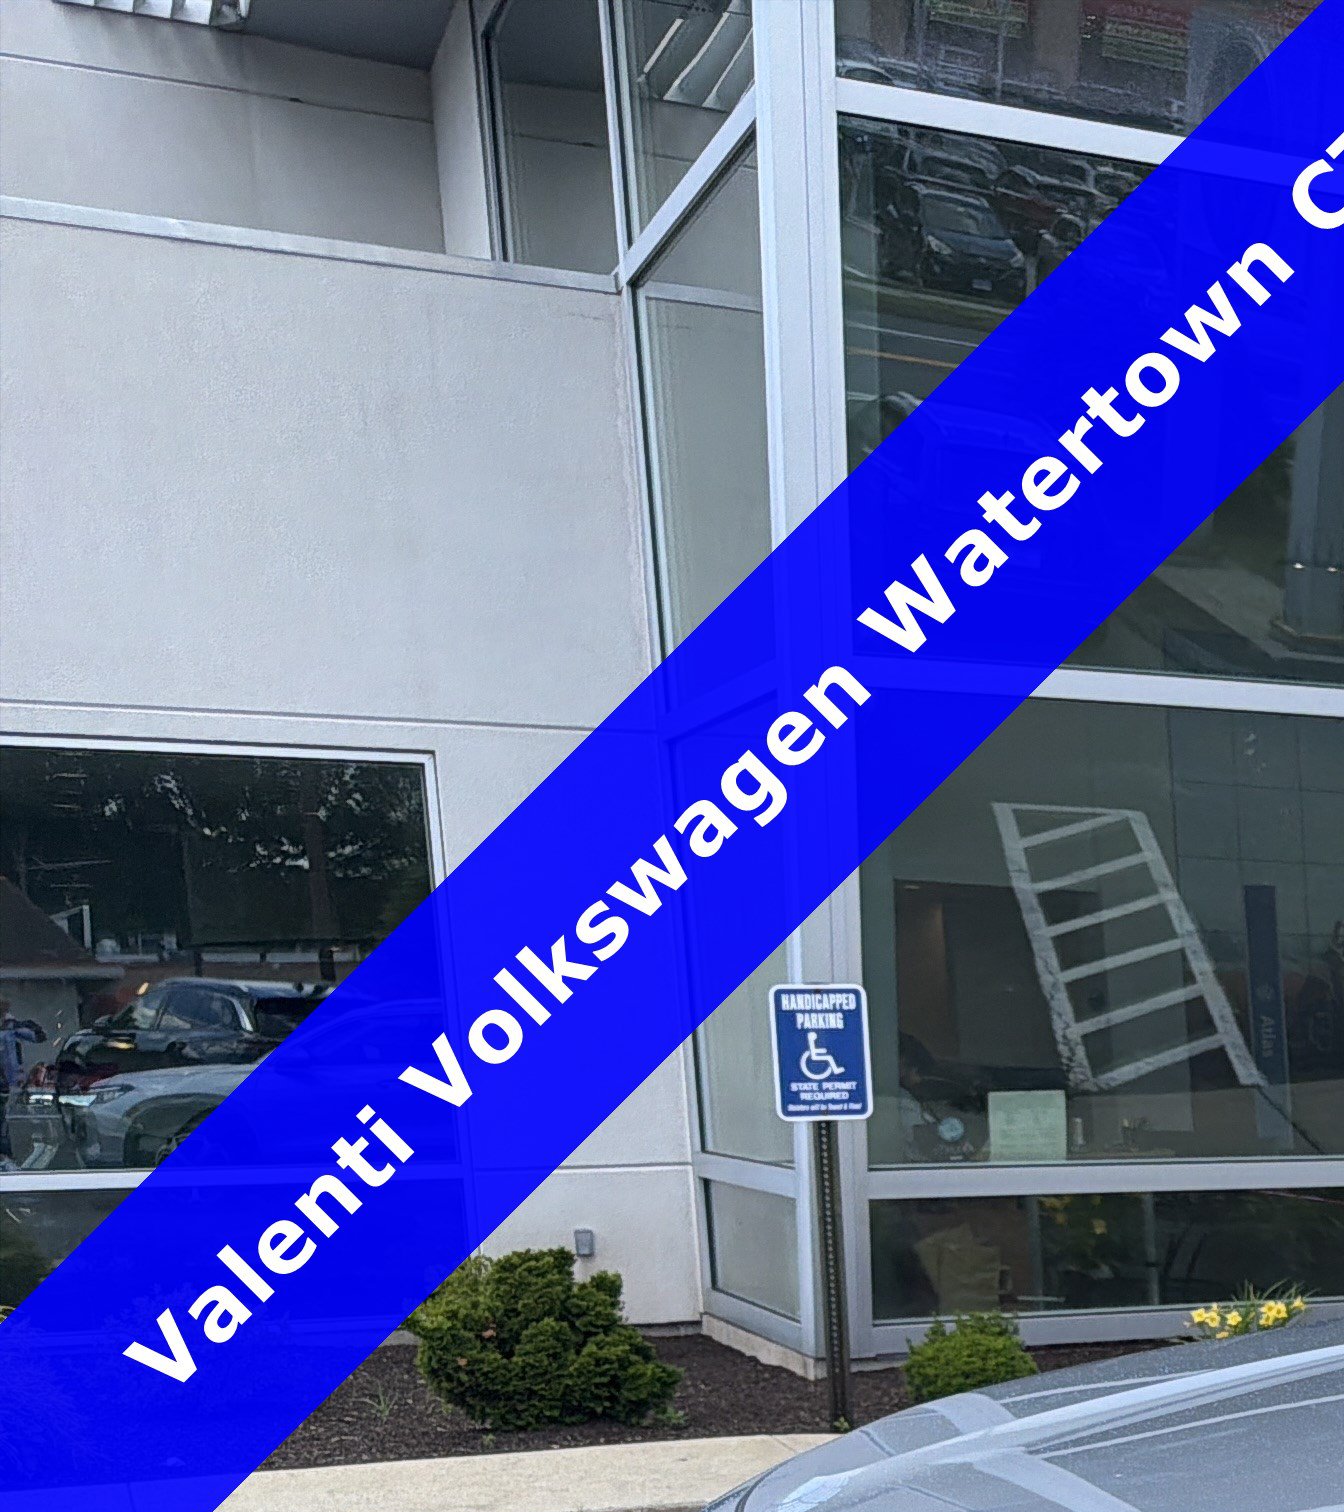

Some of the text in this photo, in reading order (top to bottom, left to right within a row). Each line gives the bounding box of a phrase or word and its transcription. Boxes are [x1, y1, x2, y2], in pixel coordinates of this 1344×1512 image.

[780, 993, 857, 1011] HANDICAPPED
[796, 1012, 845, 1030] PARKING
[790, 1081, 857, 1091] STATE PERMIT
[800, 1091, 849, 1100] REQUIRED
